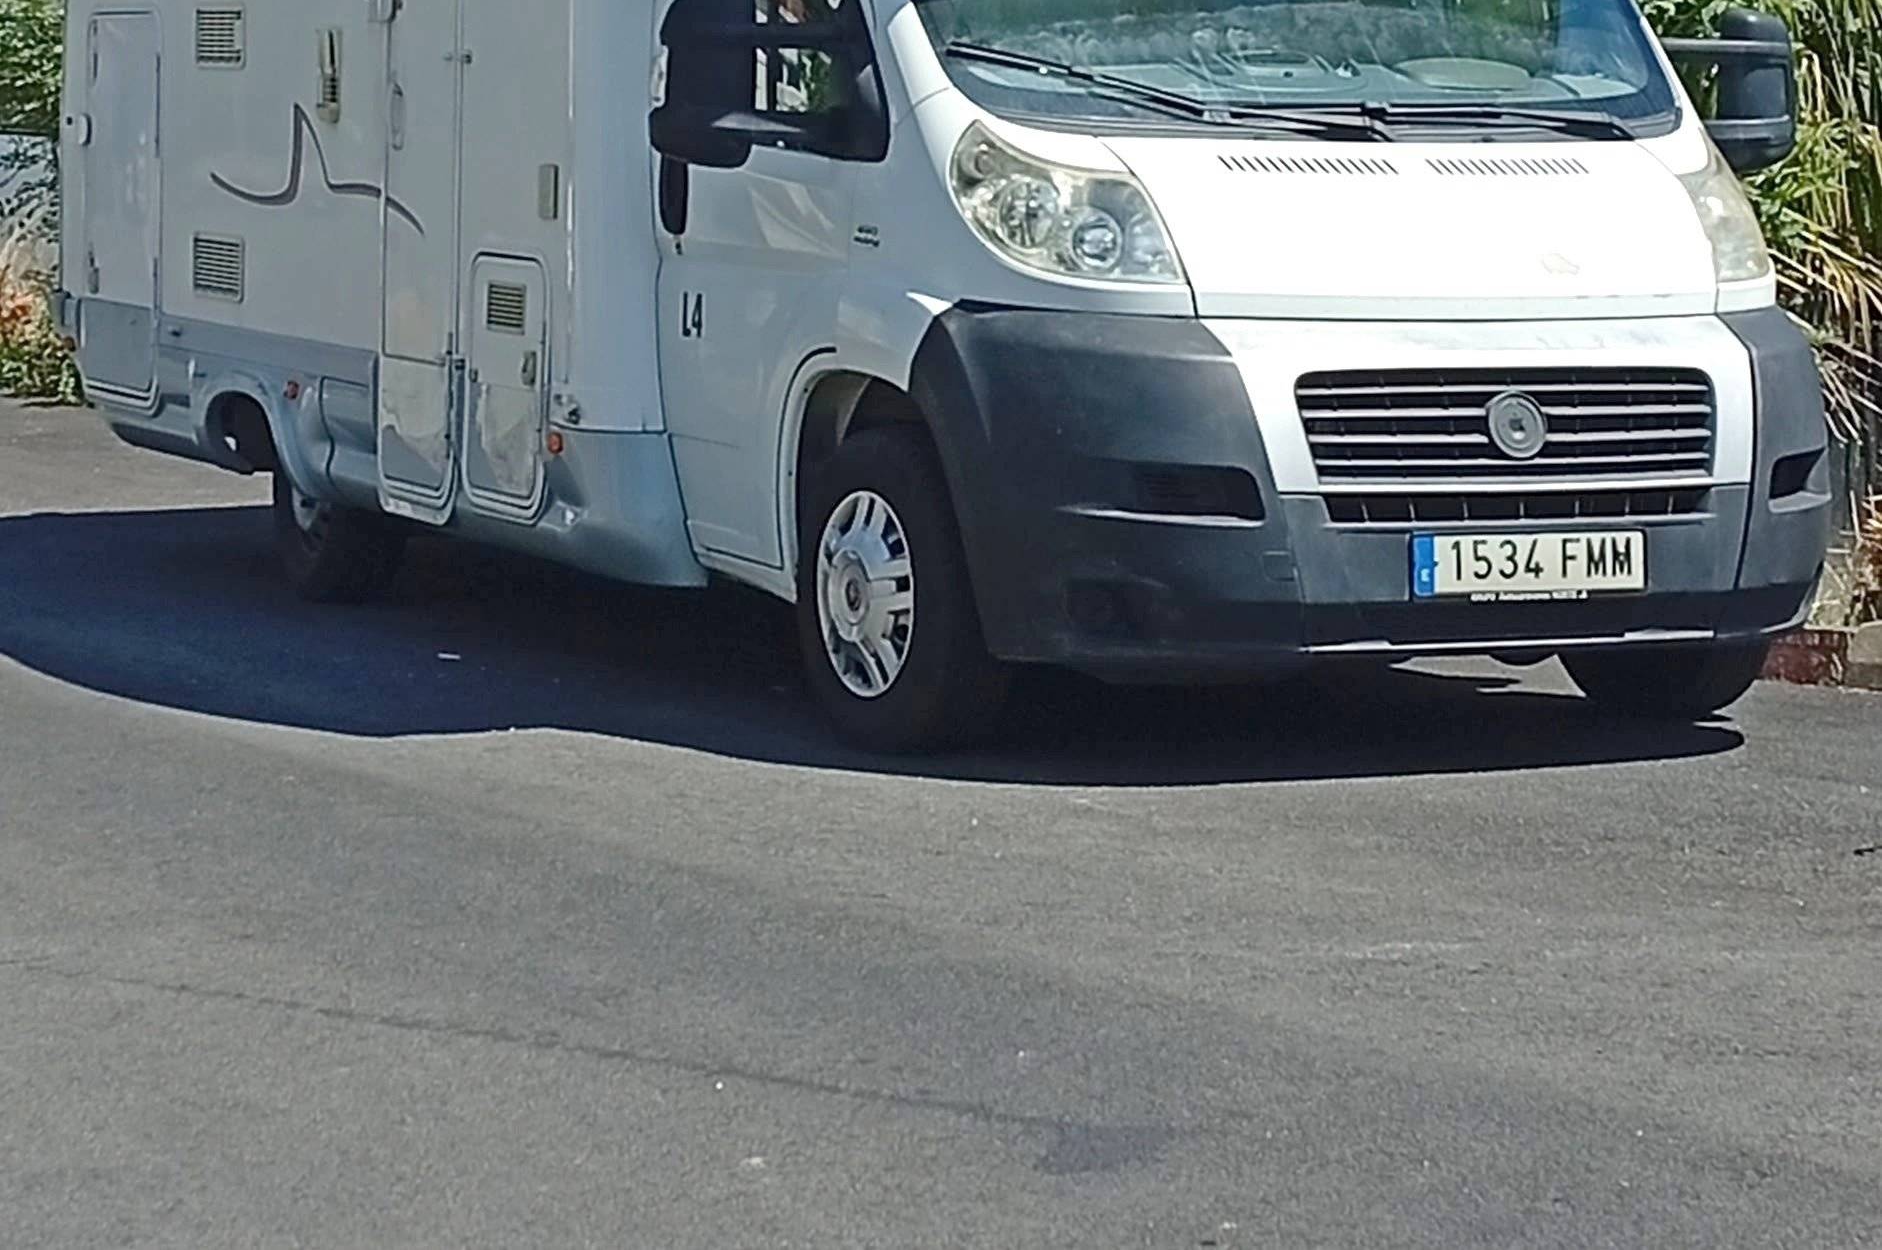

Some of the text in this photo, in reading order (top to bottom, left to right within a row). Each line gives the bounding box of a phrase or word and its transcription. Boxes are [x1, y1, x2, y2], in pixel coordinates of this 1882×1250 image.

[682, 291, 703, 338] L4
[1450, 536, 1633, 581] 1534 FMM
